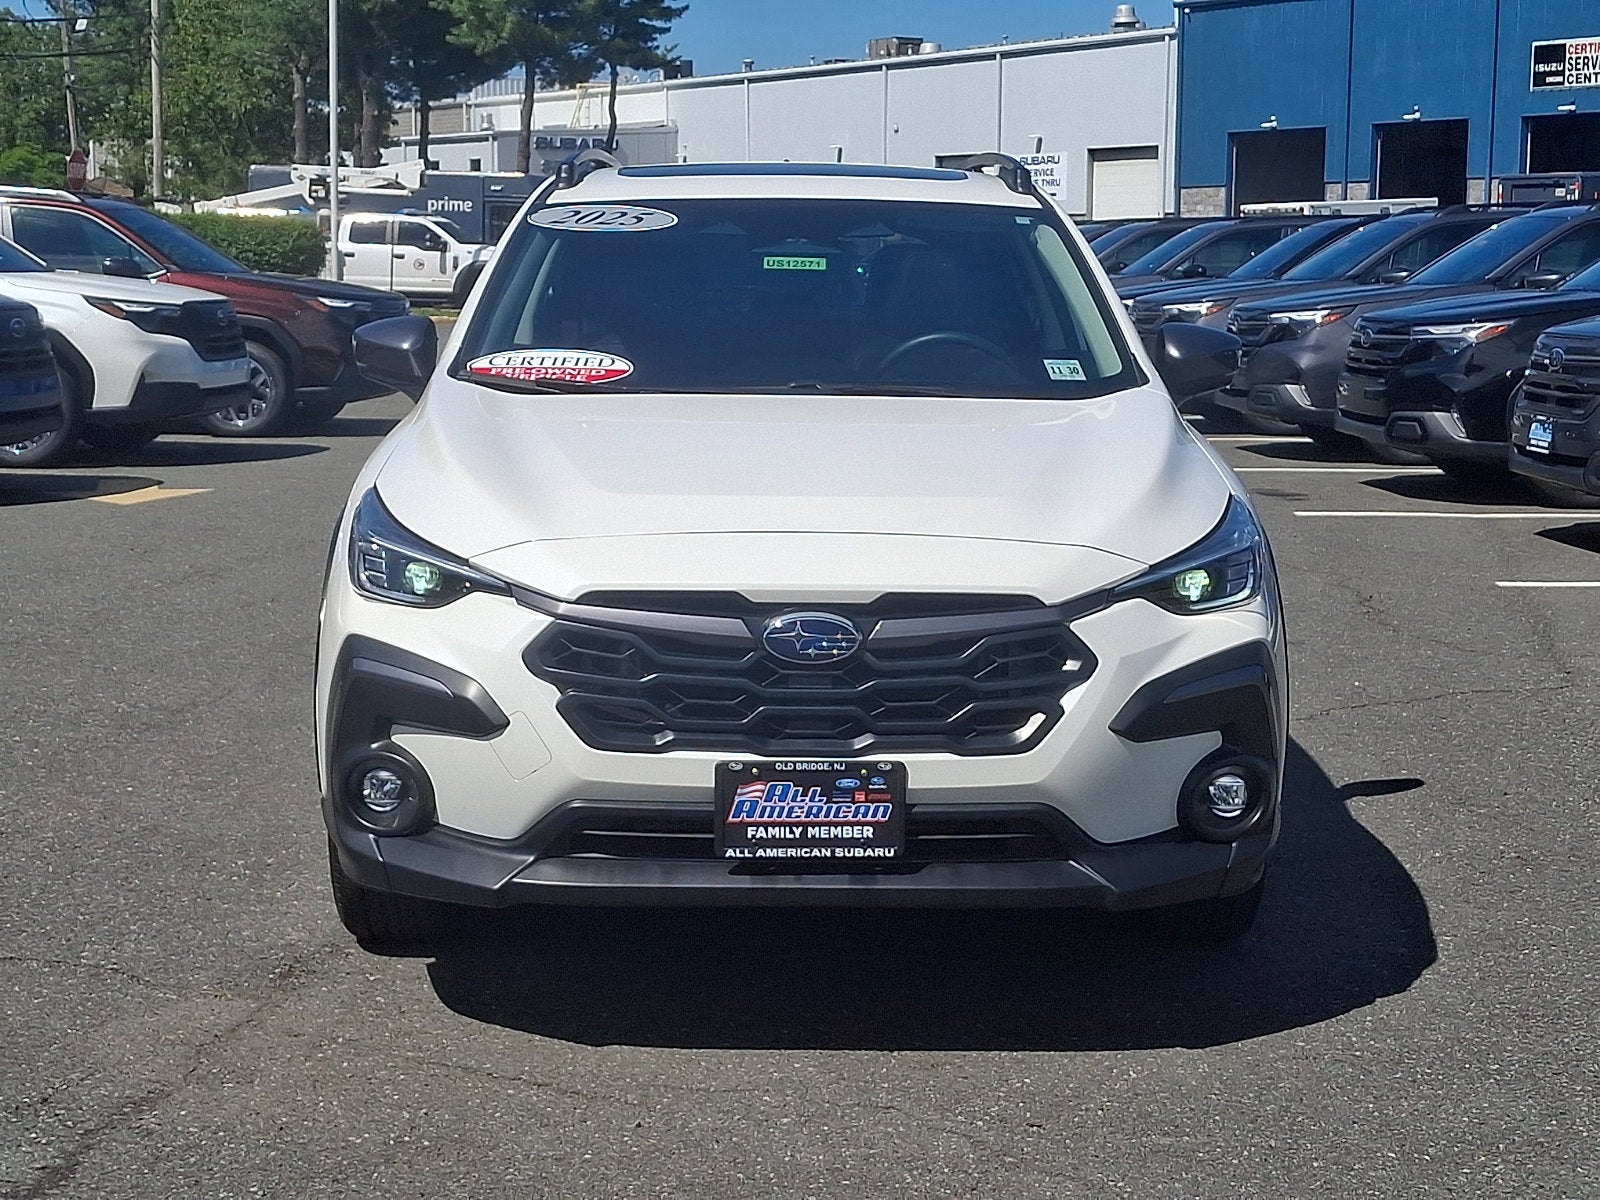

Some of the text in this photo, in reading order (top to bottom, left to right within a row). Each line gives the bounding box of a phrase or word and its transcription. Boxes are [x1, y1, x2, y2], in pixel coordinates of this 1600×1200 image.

[1535, 62, 1564, 72] ISUZU
[1567, 55, 1600, 72] SERV
[1020, 155, 1060, 165] SUBARU
[1029, 168, 1054, 177] ERVICE
[1041, 178, 1061, 187] THRU
[427, 195, 474, 213] prime
[549, 210, 653, 226] 2025
[766, 259, 821, 268] US12571
[489, 355, 616, 367] CERTIFIED
[490, 367, 606, 376] PRE-OWNED
[1050, 366, 1080, 375] 11 30
[775, 762, 794, 770] OLD
[834, 762, 845, 770] NJ
[747, 826, 874, 839] FAMILY MEMBER
[725, 848, 895, 858] ALL AMERICAN SUBARU
